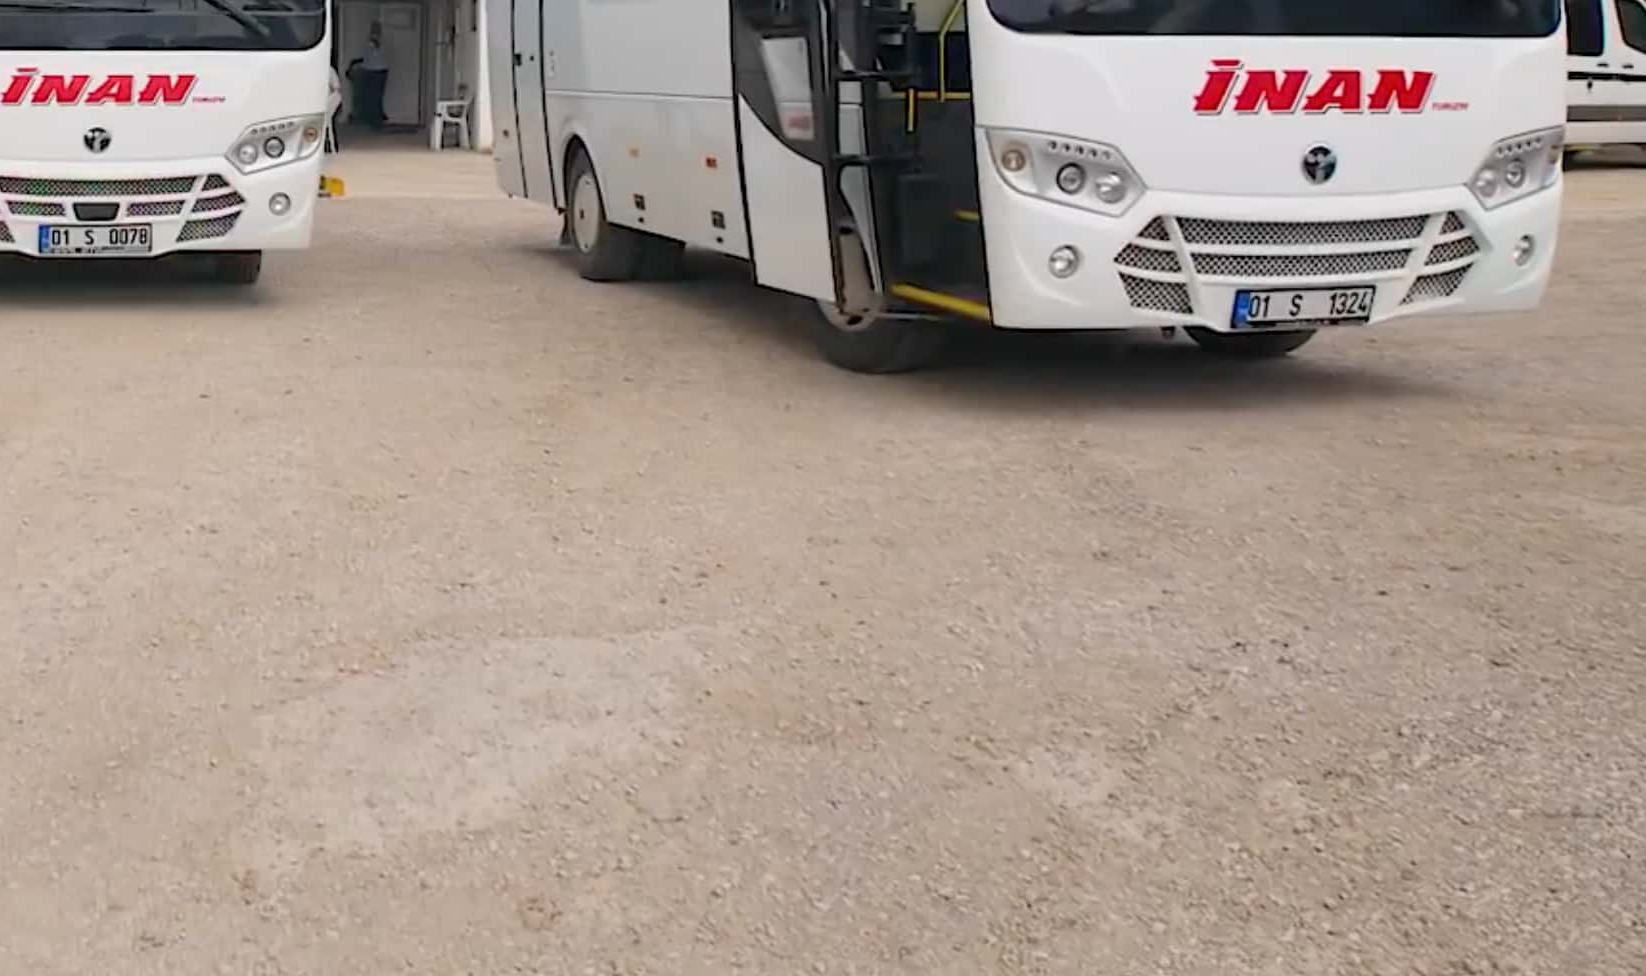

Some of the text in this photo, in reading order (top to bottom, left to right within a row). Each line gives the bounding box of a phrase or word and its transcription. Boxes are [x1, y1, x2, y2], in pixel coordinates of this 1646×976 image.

[0, 67, 198, 106] İNAN
[1193, 59, 1435, 115] İNAN
[51, 228, 148, 245] 01 S 0078
[1248, 291, 1369, 318] 01 S 1324
